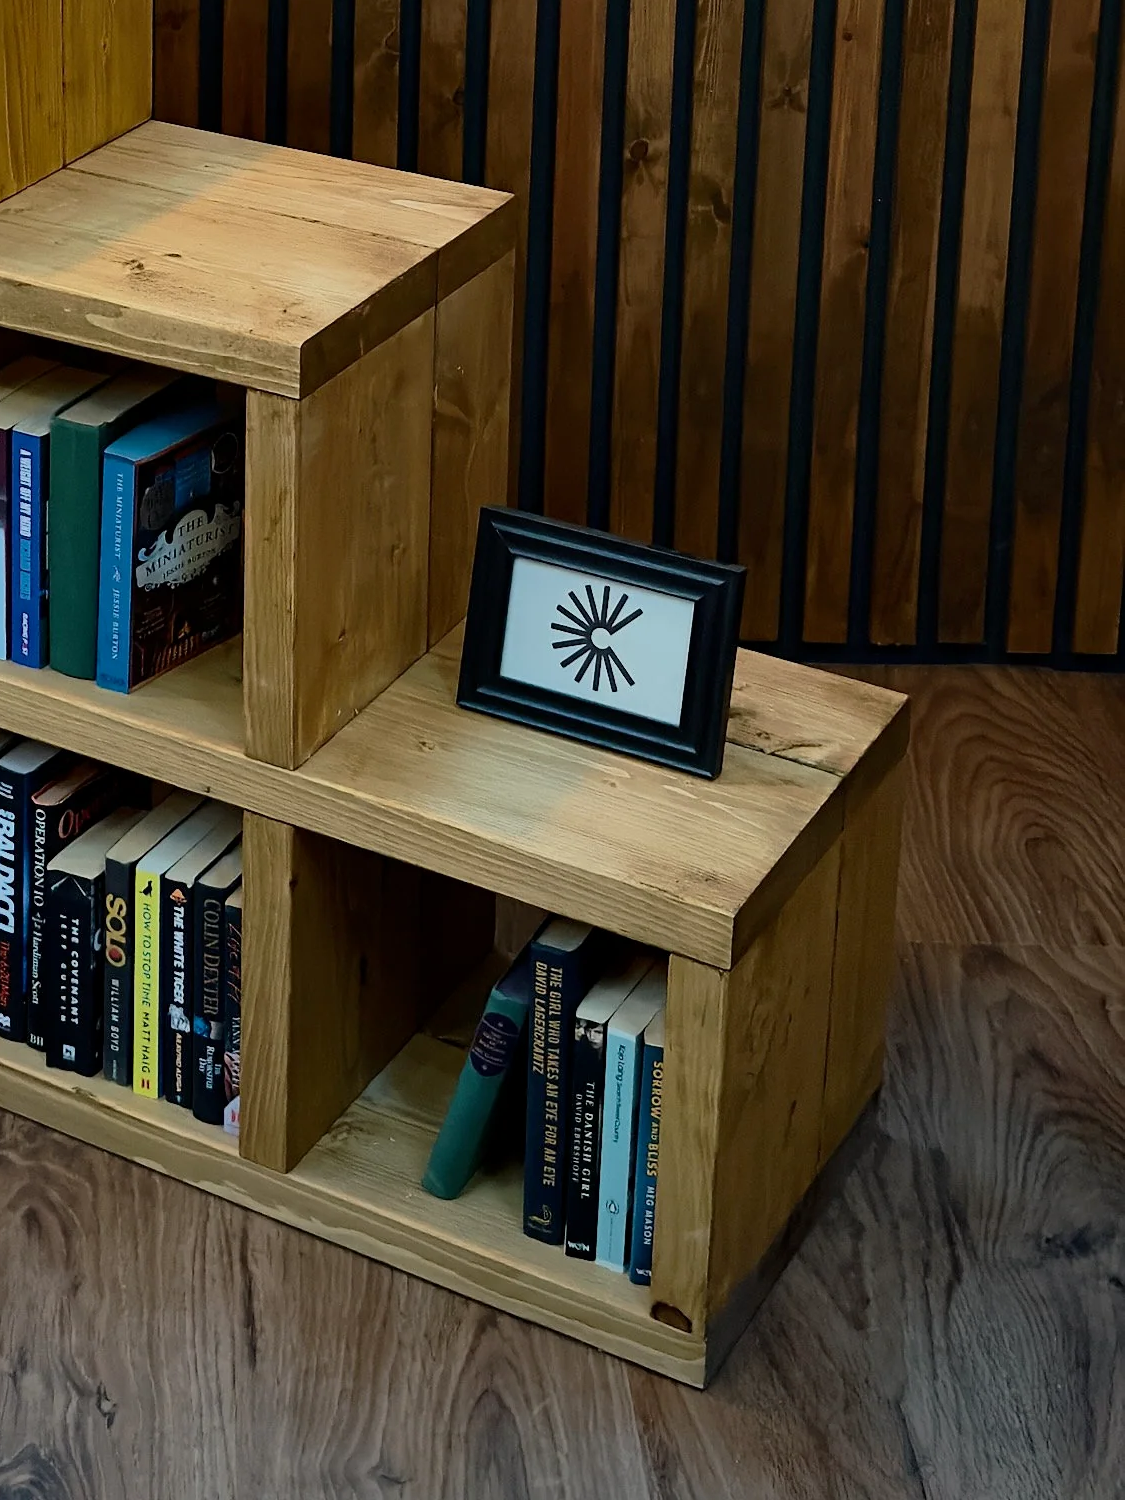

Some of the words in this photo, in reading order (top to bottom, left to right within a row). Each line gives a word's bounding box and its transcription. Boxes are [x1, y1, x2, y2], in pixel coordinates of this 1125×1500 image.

[114, 495, 123, 559] MINIATURIST
[178, 515, 204, 537] THE
[144, 523, 234, 577] MINIATURIST
[112, 588, 121, 622] JESSIE
[111, 623, 120, 660] BURTON
[33, 808, 46, 889] OPERATION
[70, 918, 80, 944] THE
[105, 893, 127, 968] SOLO
[142, 903, 152, 932] HOW
[173, 905, 185, 930] THE
[204, 899, 221, 950] COLIN
[32, 931, 42, 978] Hardiman
[142, 934, 151, 948] TO
[173, 931, 184, 970] WHITE
[142, 952, 151, 980] STOP
[535, 960, 547, 996] DAVID
[549, 966, 563, 988] THE
[70, 950, 79, 1025] COVENANT
[142, 982, 151, 1007] TIME
[173, 971, 185, 1004] TIGER
[203, 952, 220, 1015] DEXTER
[111, 978, 120, 1022] WILLIAM
[548, 991, 562, 1016] GIRL
[110, 1025, 120, 1052] BOYD
[142, 1012, 151, 1042] MATT
[532, 997, 546, 1075] LAGERCRANTZ
[547, 1020, 561, 1044] WHO
[142, 1045, 150, 1073] HAIG
[546, 1047, 560, 1080] TAKES
[546, 1081, 559, 1098] AN
[585, 1081, 595, 1107] THE
[650, 1060, 663, 1120] SORROW
[545, 1100, 558, 1122] EYE
[575, 1093, 583, 1123] DAVID
[544, 1124, 558, 1145] FOR
[583, 1112, 594, 1163] DANISH
[650, 1121, 659, 1141] AND
[543, 1146, 557, 1163] AN
[571, 1127, 582, 1183] EBERSHOFF
[646, 1143, 659, 1177] BLISS
[542, 1165, 556, 1187] EYE
[580, 1168, 591, 1200] GIRL
[644, 1185, 655, 1206] MEG
[643, 1209, 654, 1245] MASON
